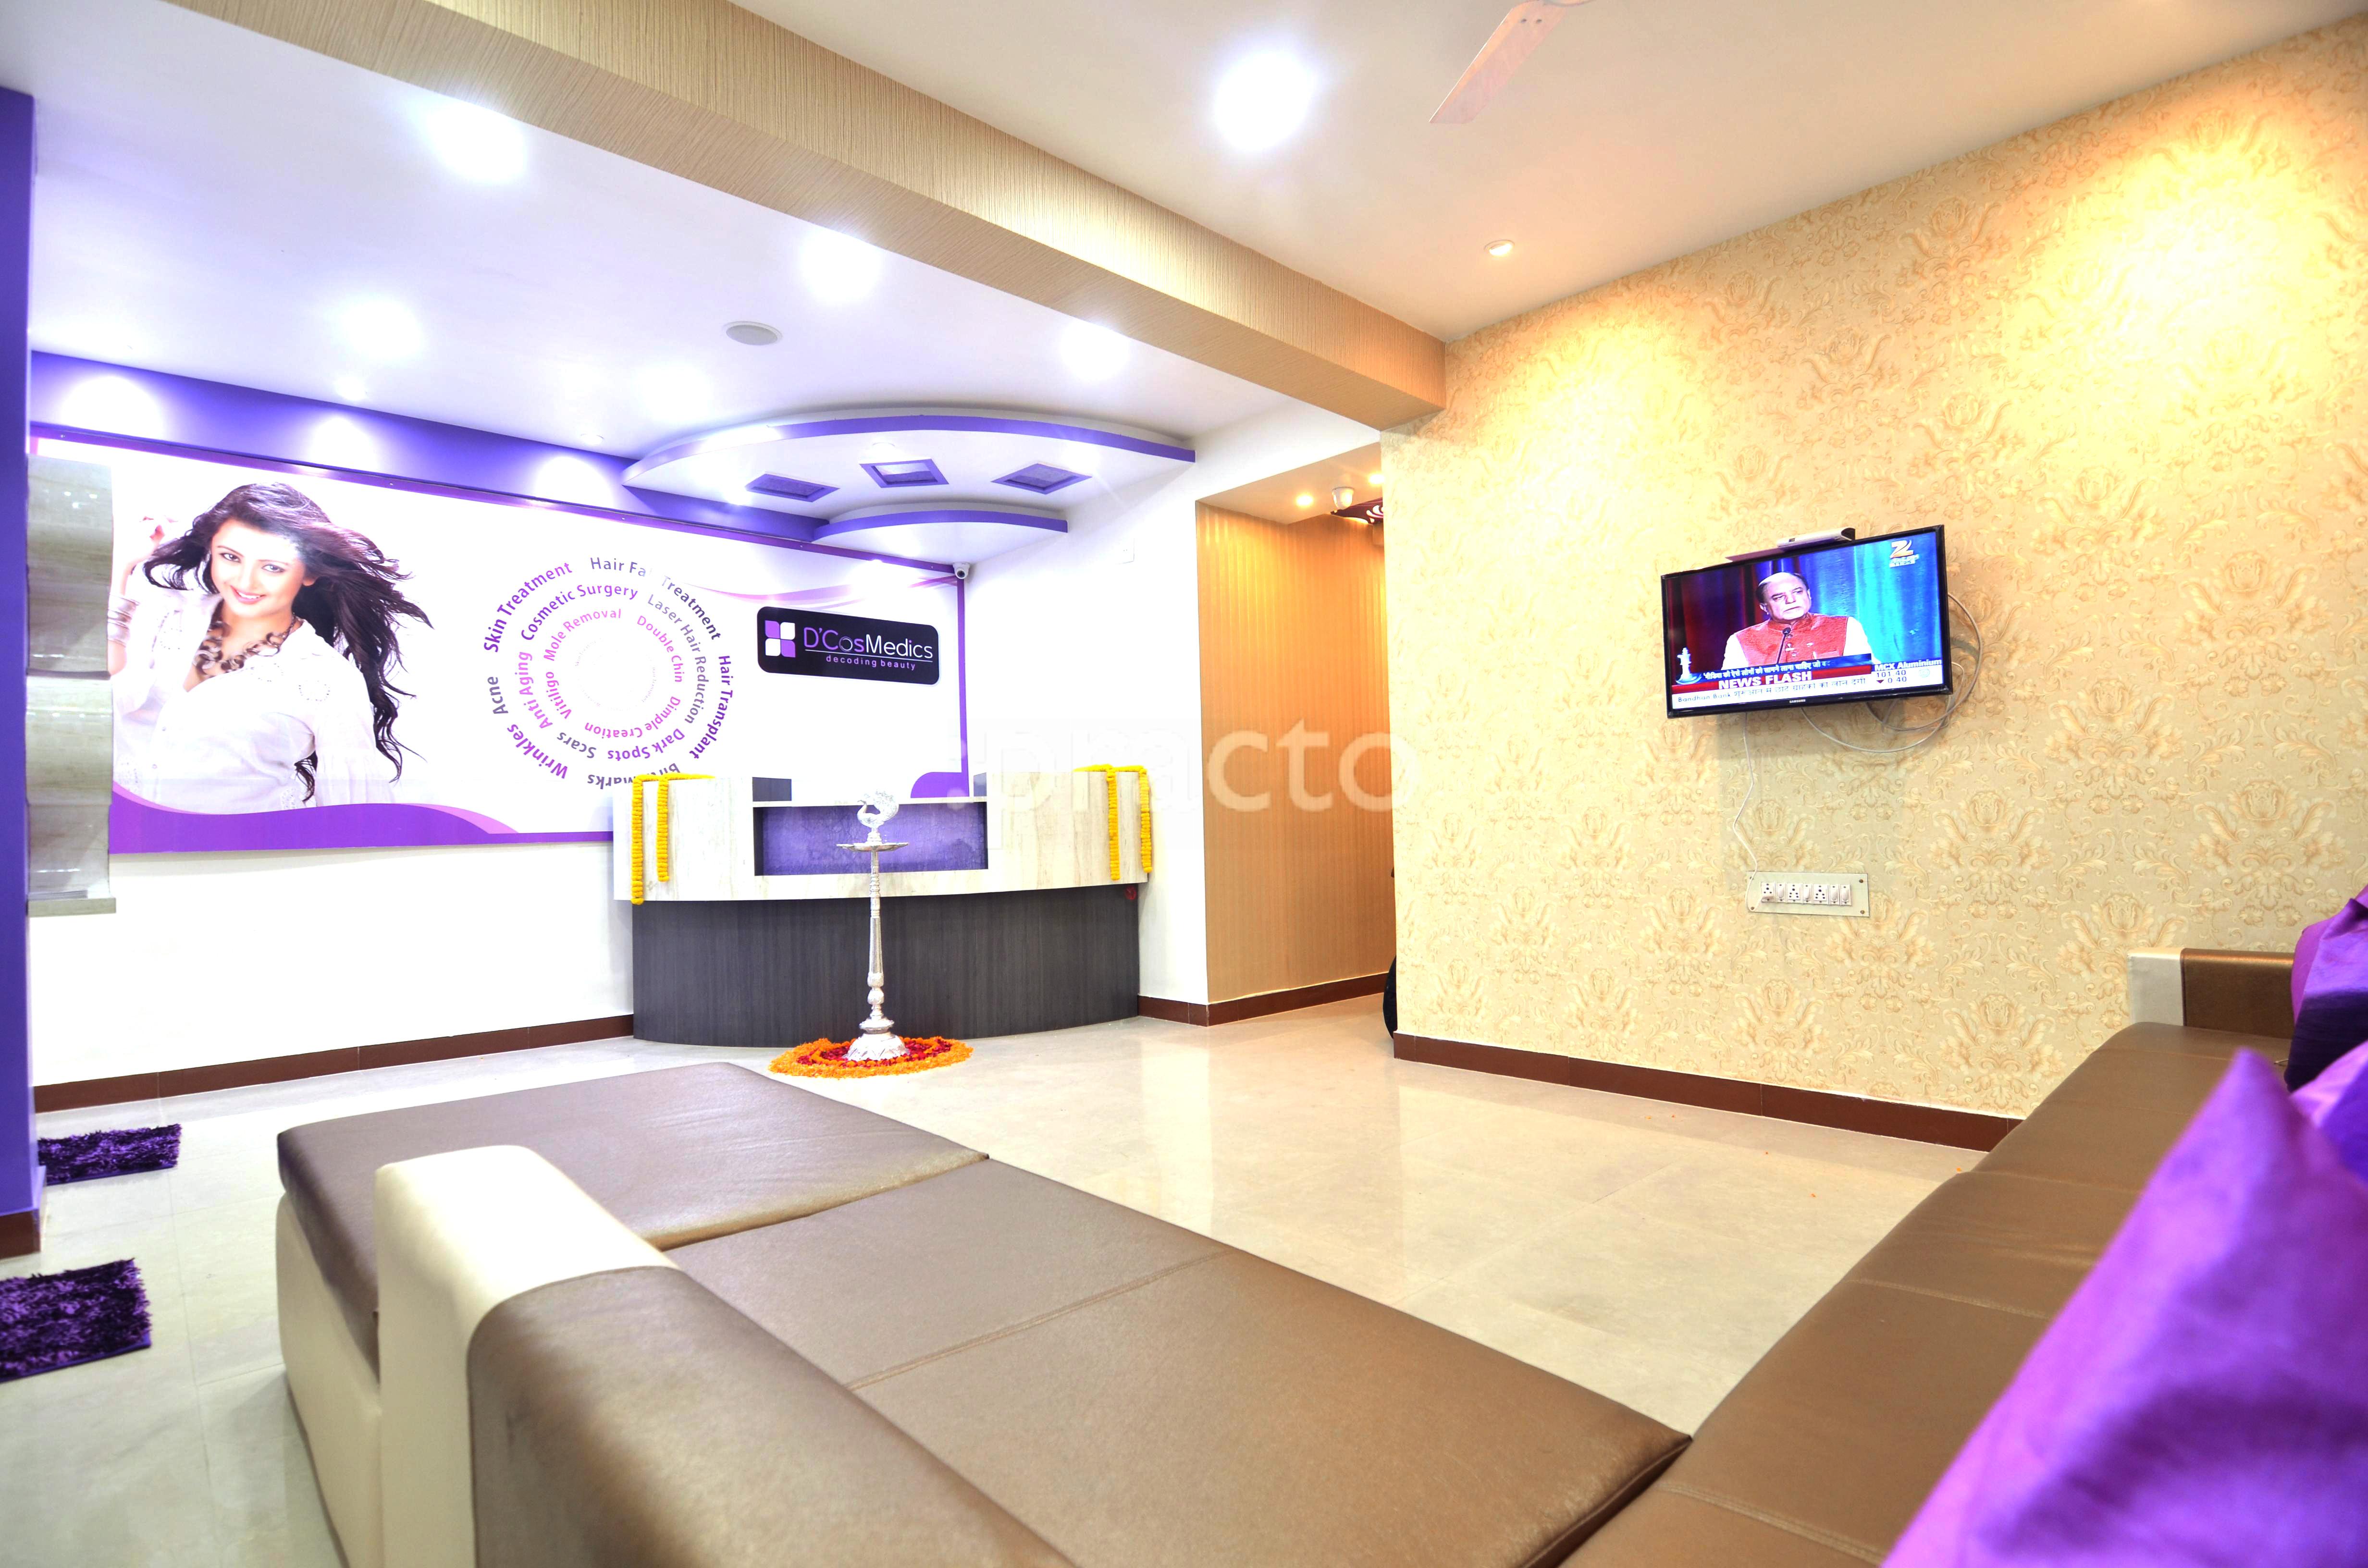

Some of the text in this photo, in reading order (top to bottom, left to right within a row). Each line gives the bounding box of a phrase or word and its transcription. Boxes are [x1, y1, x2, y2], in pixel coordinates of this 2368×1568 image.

[484, 563, 572, 652] Skin Treatment
[521, 585, 638, 640] Cosmetic Surgery
[591, 557, 624, 571] Hair
[662, 576, 721, 640] Treatment
[543, 632, 566, 661] Mole
[563, 609, 621, 632] Removal
[637, 615, 674, 652] Double
[671, 655, 684, 682] Chin
[648, 594, 709, 723] Laser Hair Reduction
[826, 655, 915, 671] decoding beauty
[1718, 671, 1812, 689] NEWS FLASH
[1875, 659, 1942, 672] MCX Aluminium
[487, 676, 508, 714] Acne
[515, 652, 553, 729] Anti Aging
[546, 672, 572, 719] Vitiligo
[689, 656, 733, 759] Hair Transplant
[585, 696, 680, 738] Dimple Creation
[507, 724, 568, 779] Wrinkles
[556, 732, 597, 758] Scars
[607, 728, 685, 761] Dark Spots
